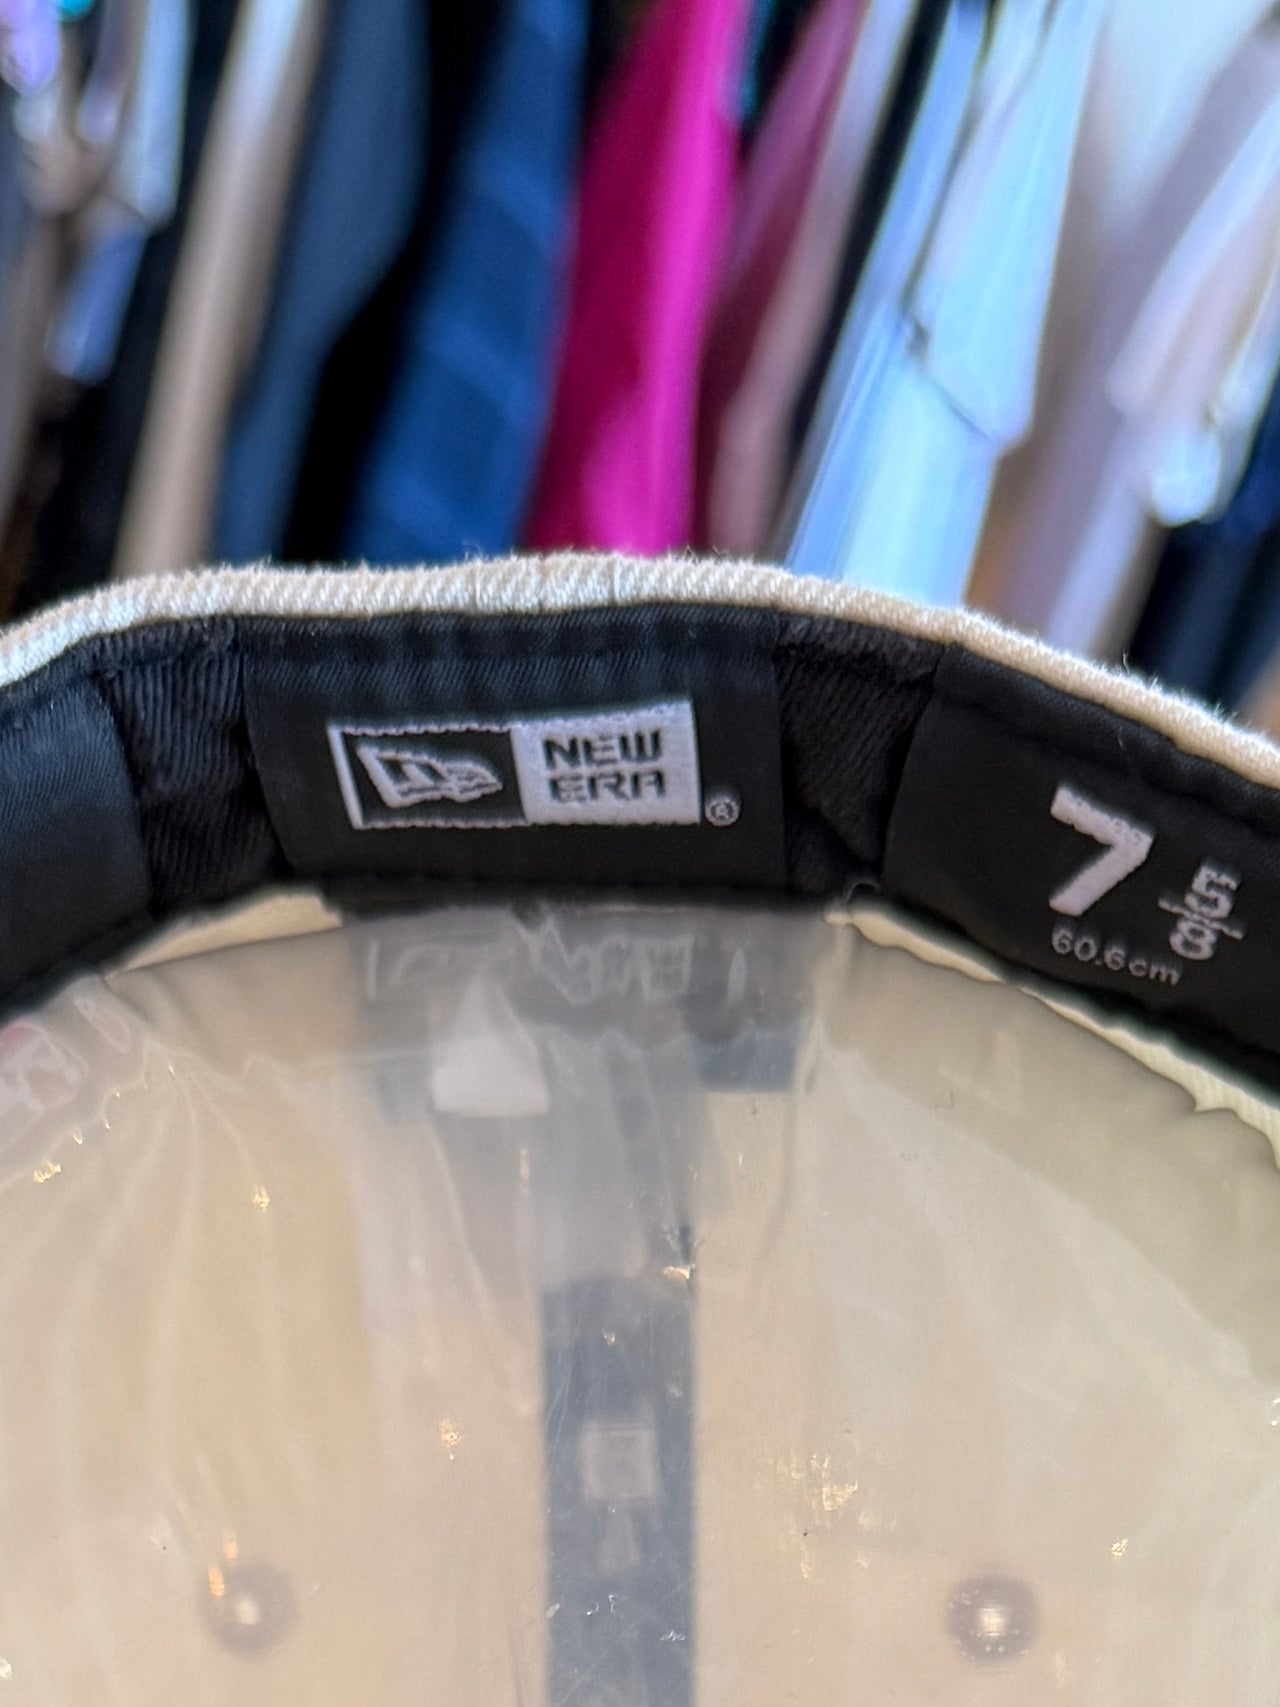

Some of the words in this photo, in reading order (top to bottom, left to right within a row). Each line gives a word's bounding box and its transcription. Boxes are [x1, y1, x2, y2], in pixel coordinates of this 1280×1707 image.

[541, 730, 664, 770] NEW
[548, 771, 666, 800] ERA
[1049, 784, 1155, 916] 7
